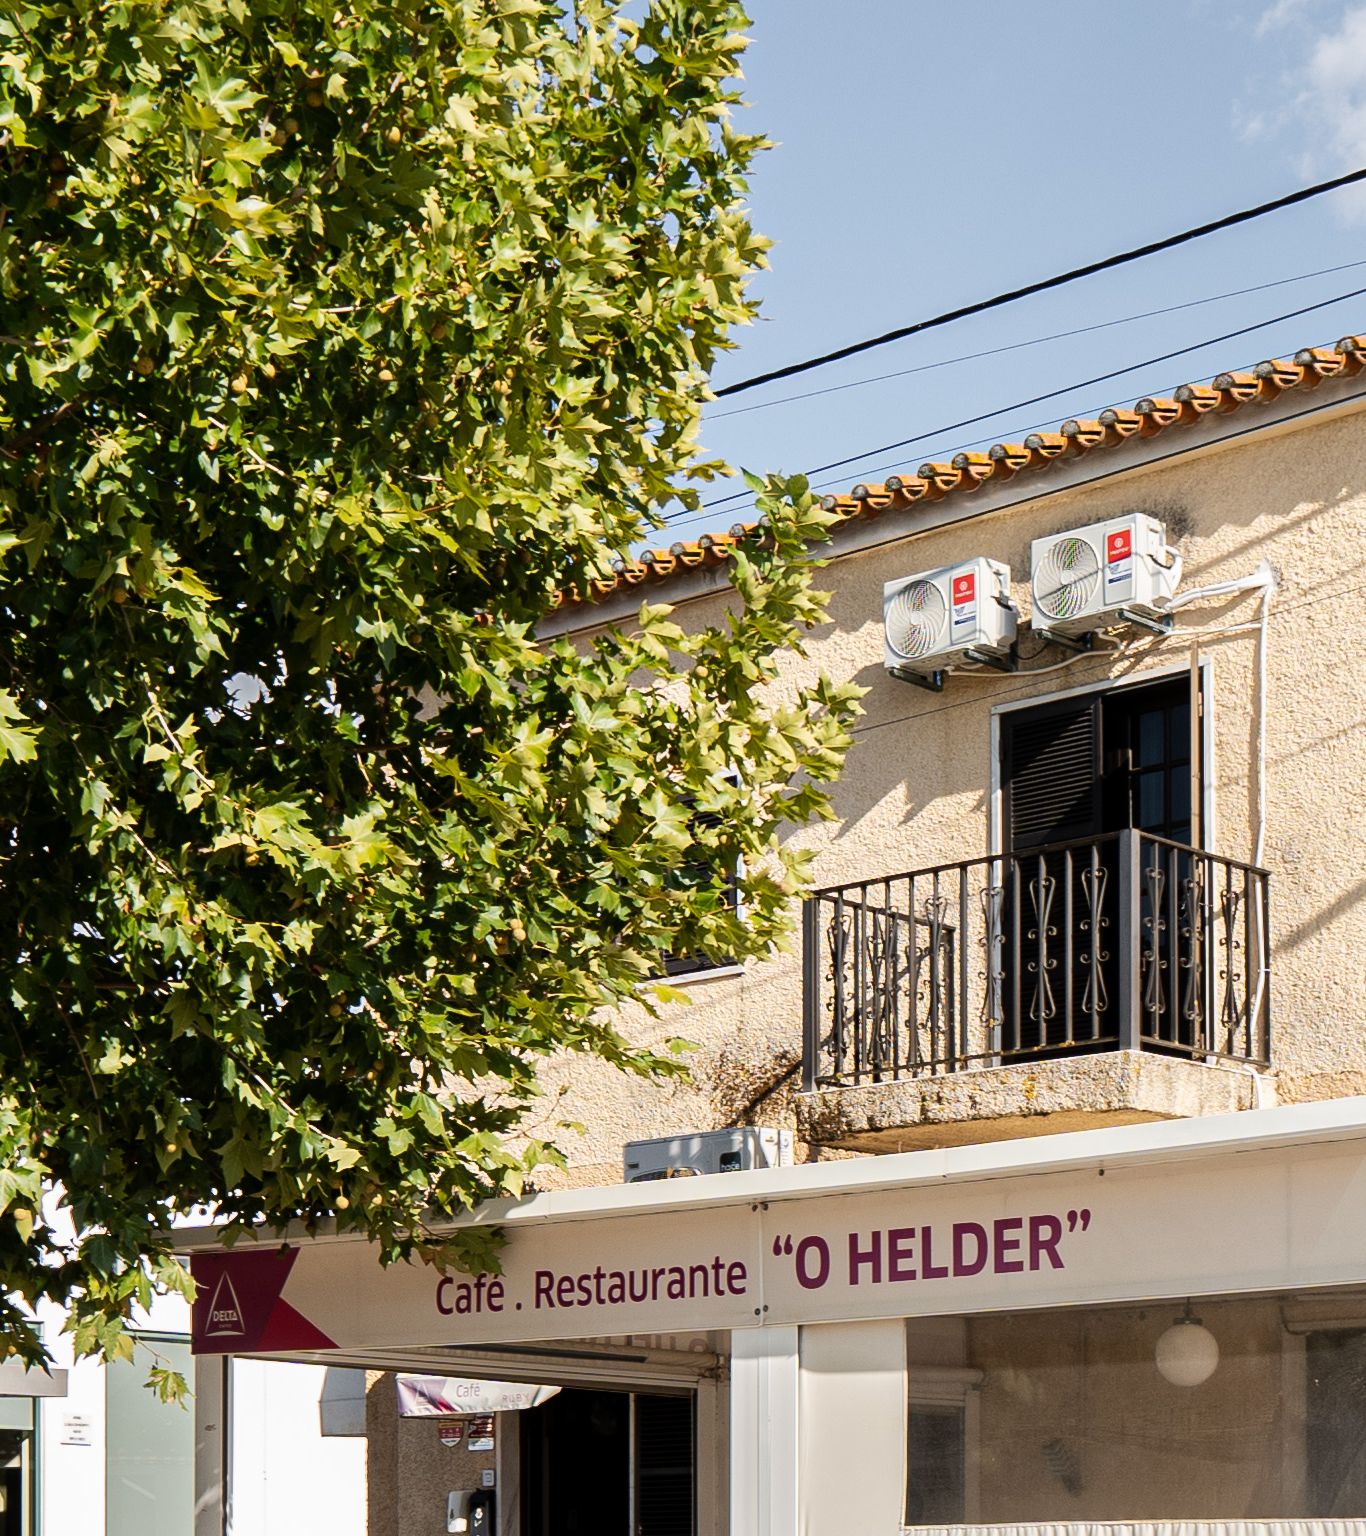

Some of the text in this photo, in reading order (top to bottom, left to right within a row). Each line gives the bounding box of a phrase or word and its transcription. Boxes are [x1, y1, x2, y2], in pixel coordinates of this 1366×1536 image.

[436, 1272, 505, 1316] Café
[534, 1256, 748, 1309] Restaurante
[212, 1310, 239, 1322] DELTA
[456, 1382, 481, 1399] Café
[501, 1392, 531, 1404] RUBY
